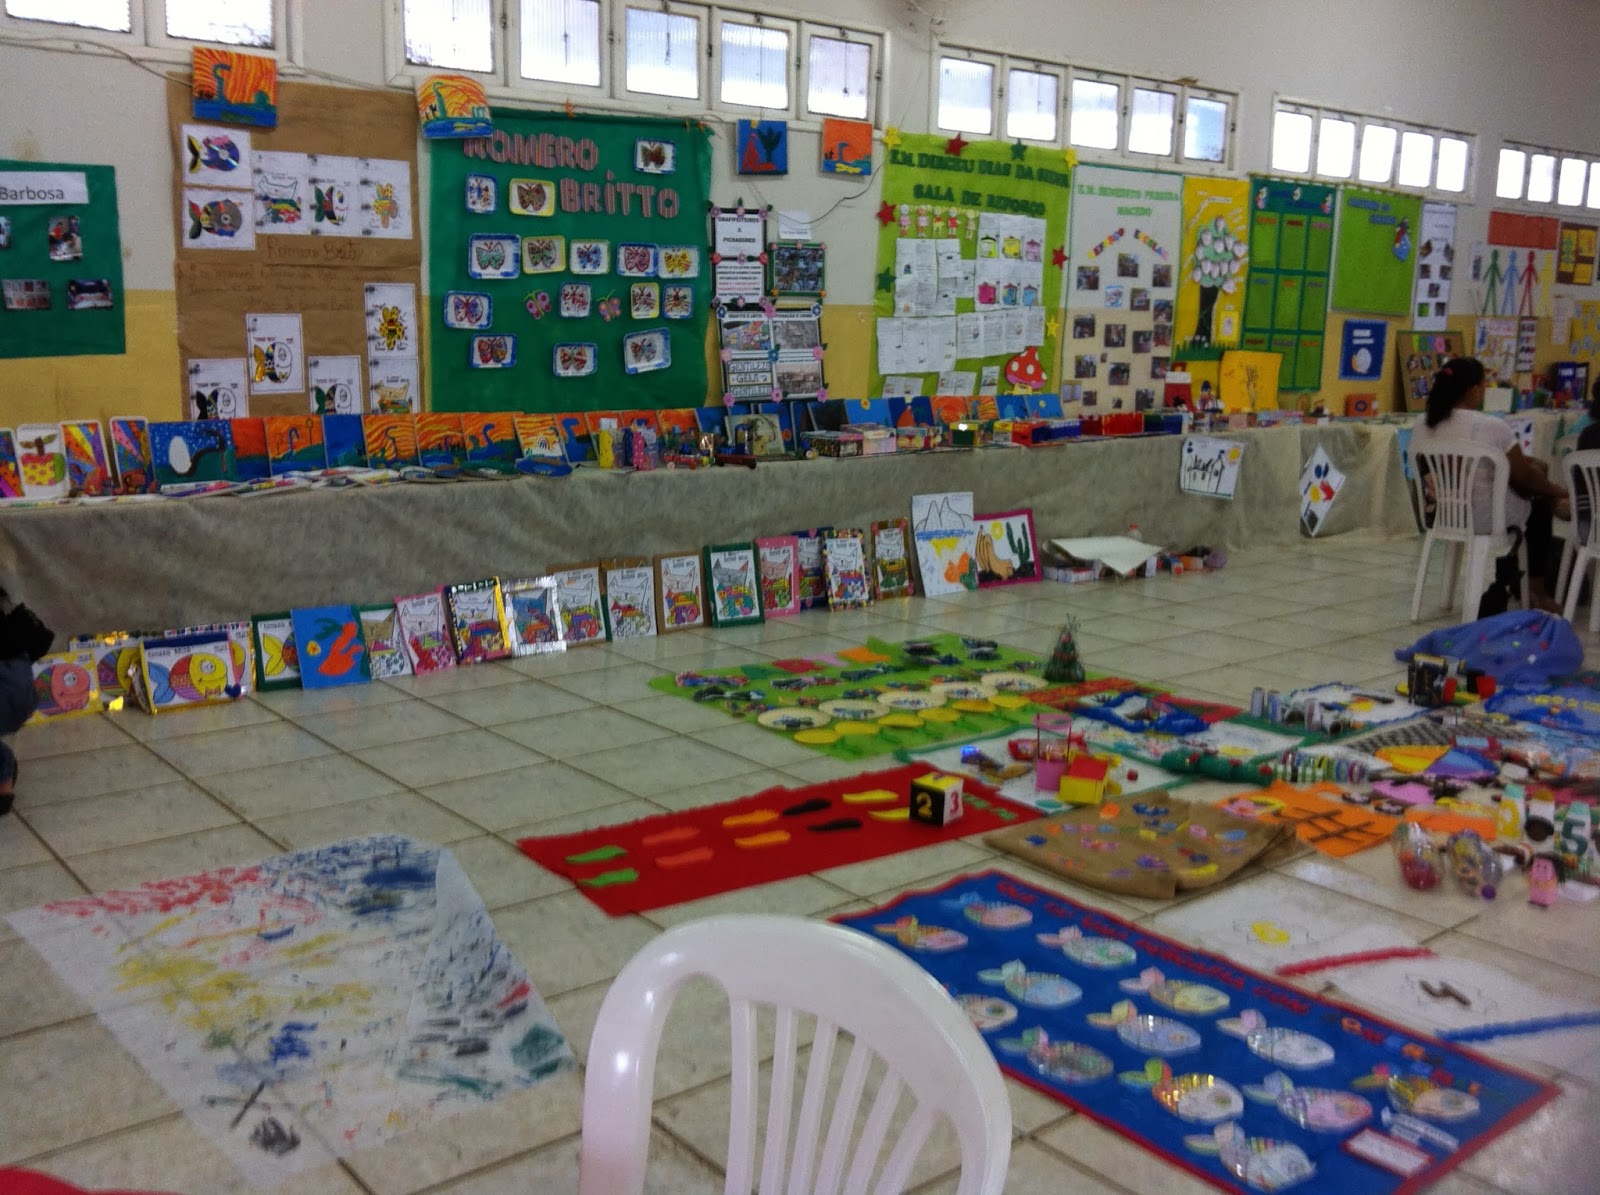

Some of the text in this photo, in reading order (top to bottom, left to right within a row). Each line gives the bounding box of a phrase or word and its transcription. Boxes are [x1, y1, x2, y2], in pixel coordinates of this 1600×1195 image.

[0, 186, 65, 200] Barbosa
[914, 183, 954, 202] SALA
[961, 190, 981, 206] DE
[915, 791, 933, 818] 2
[1561, 818, 1589, 857] 5
